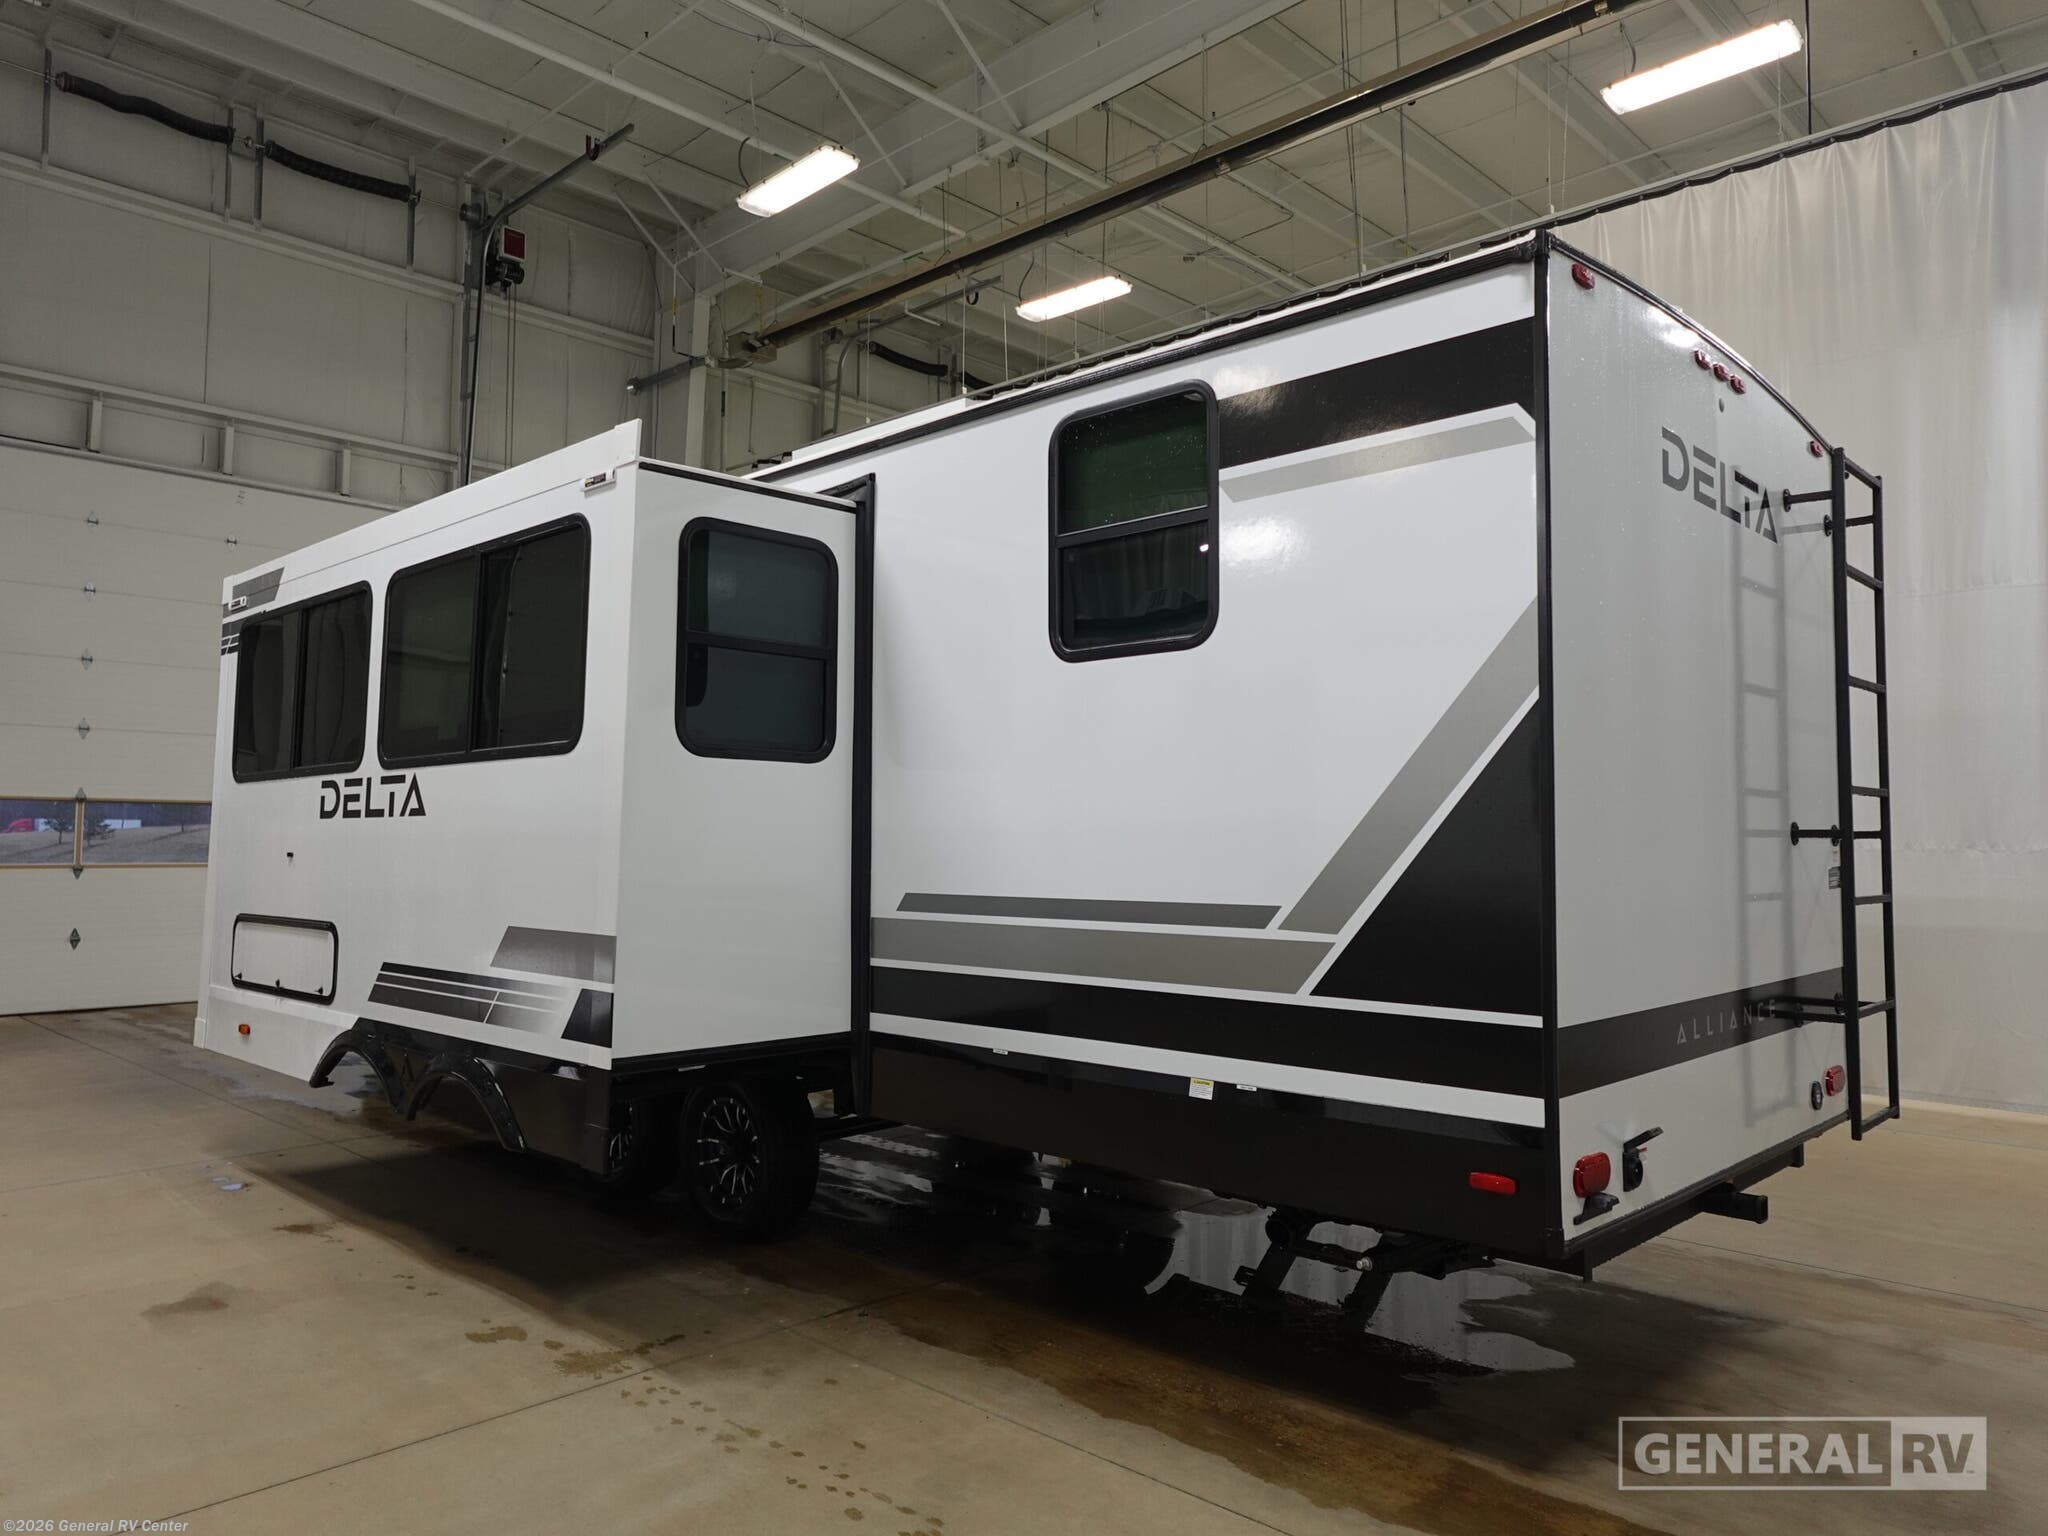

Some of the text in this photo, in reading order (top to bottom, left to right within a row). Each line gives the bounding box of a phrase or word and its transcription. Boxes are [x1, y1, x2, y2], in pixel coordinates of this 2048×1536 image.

[1661, 426, 1778, 544] DELTA
[320, 772, 426, 820] DELTA
[1676, 999, 1777, 1045] ALLIANCE
